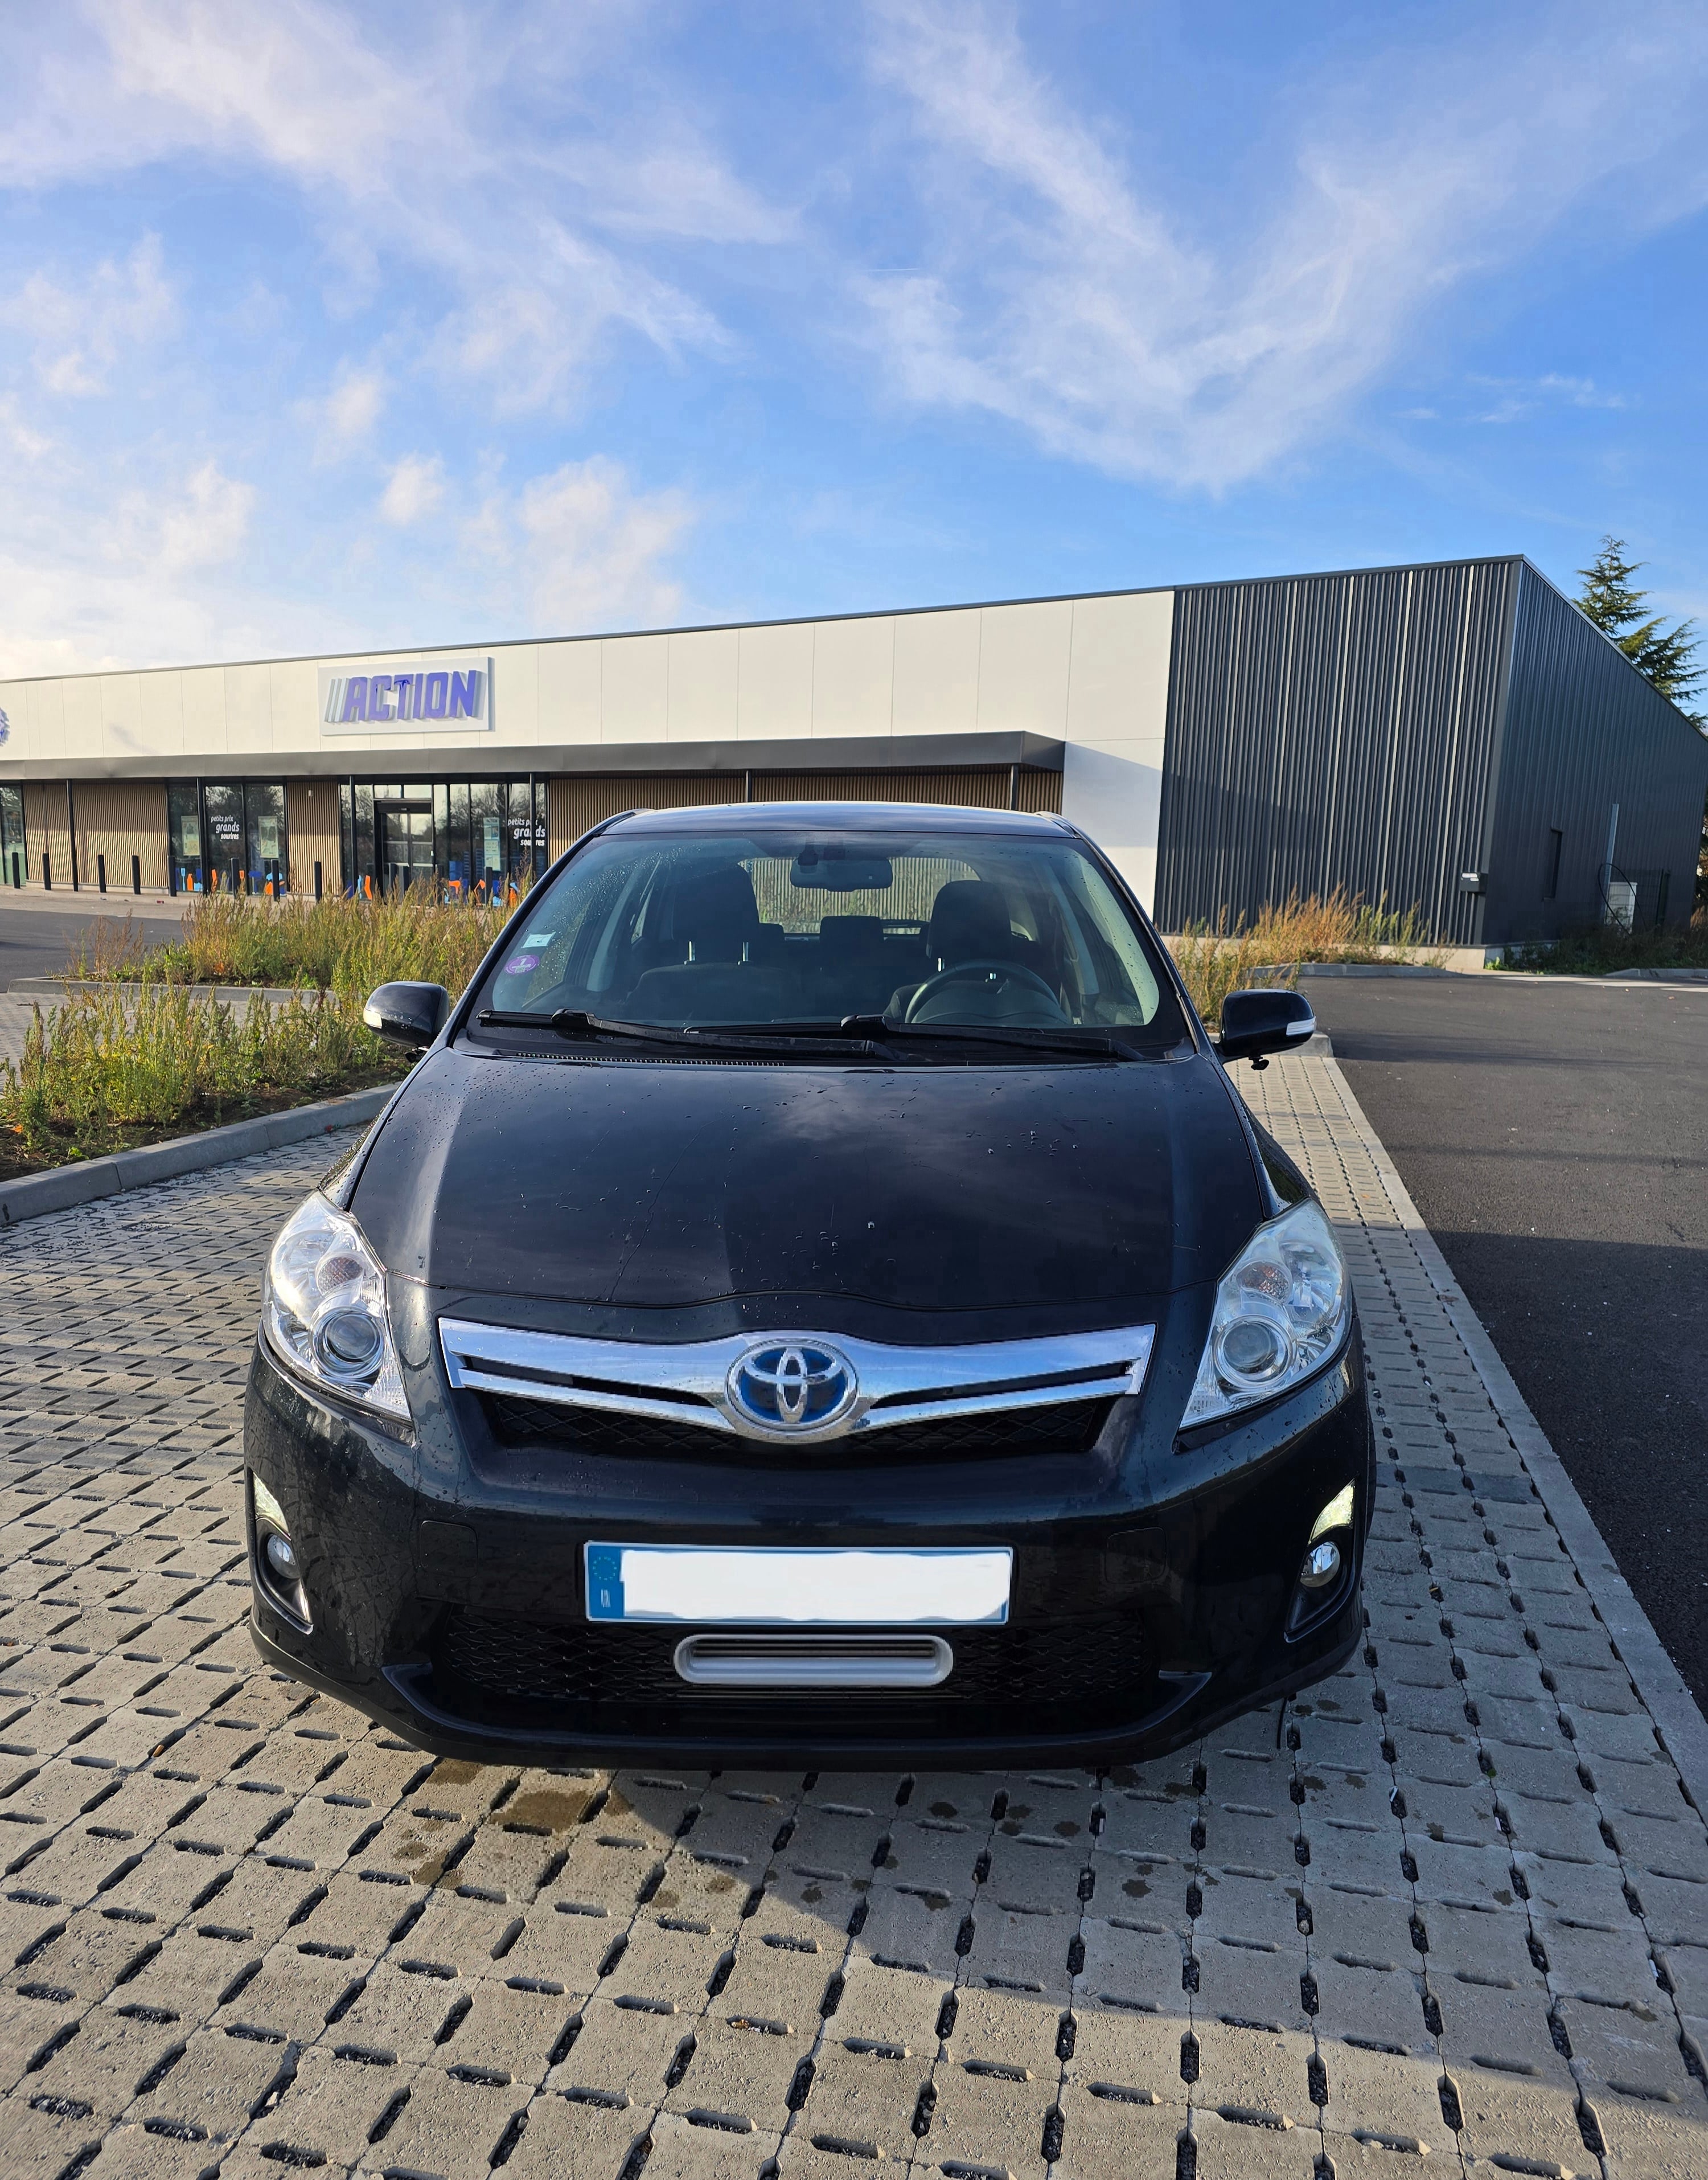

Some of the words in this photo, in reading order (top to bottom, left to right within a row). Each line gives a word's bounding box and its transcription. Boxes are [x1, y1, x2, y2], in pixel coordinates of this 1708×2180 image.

[342, 670, 477, 722] ACTION
[216, 821, 240, 834] grands
[507, 817, 525, 827] petits
[513, 825, 545, 839] grads
